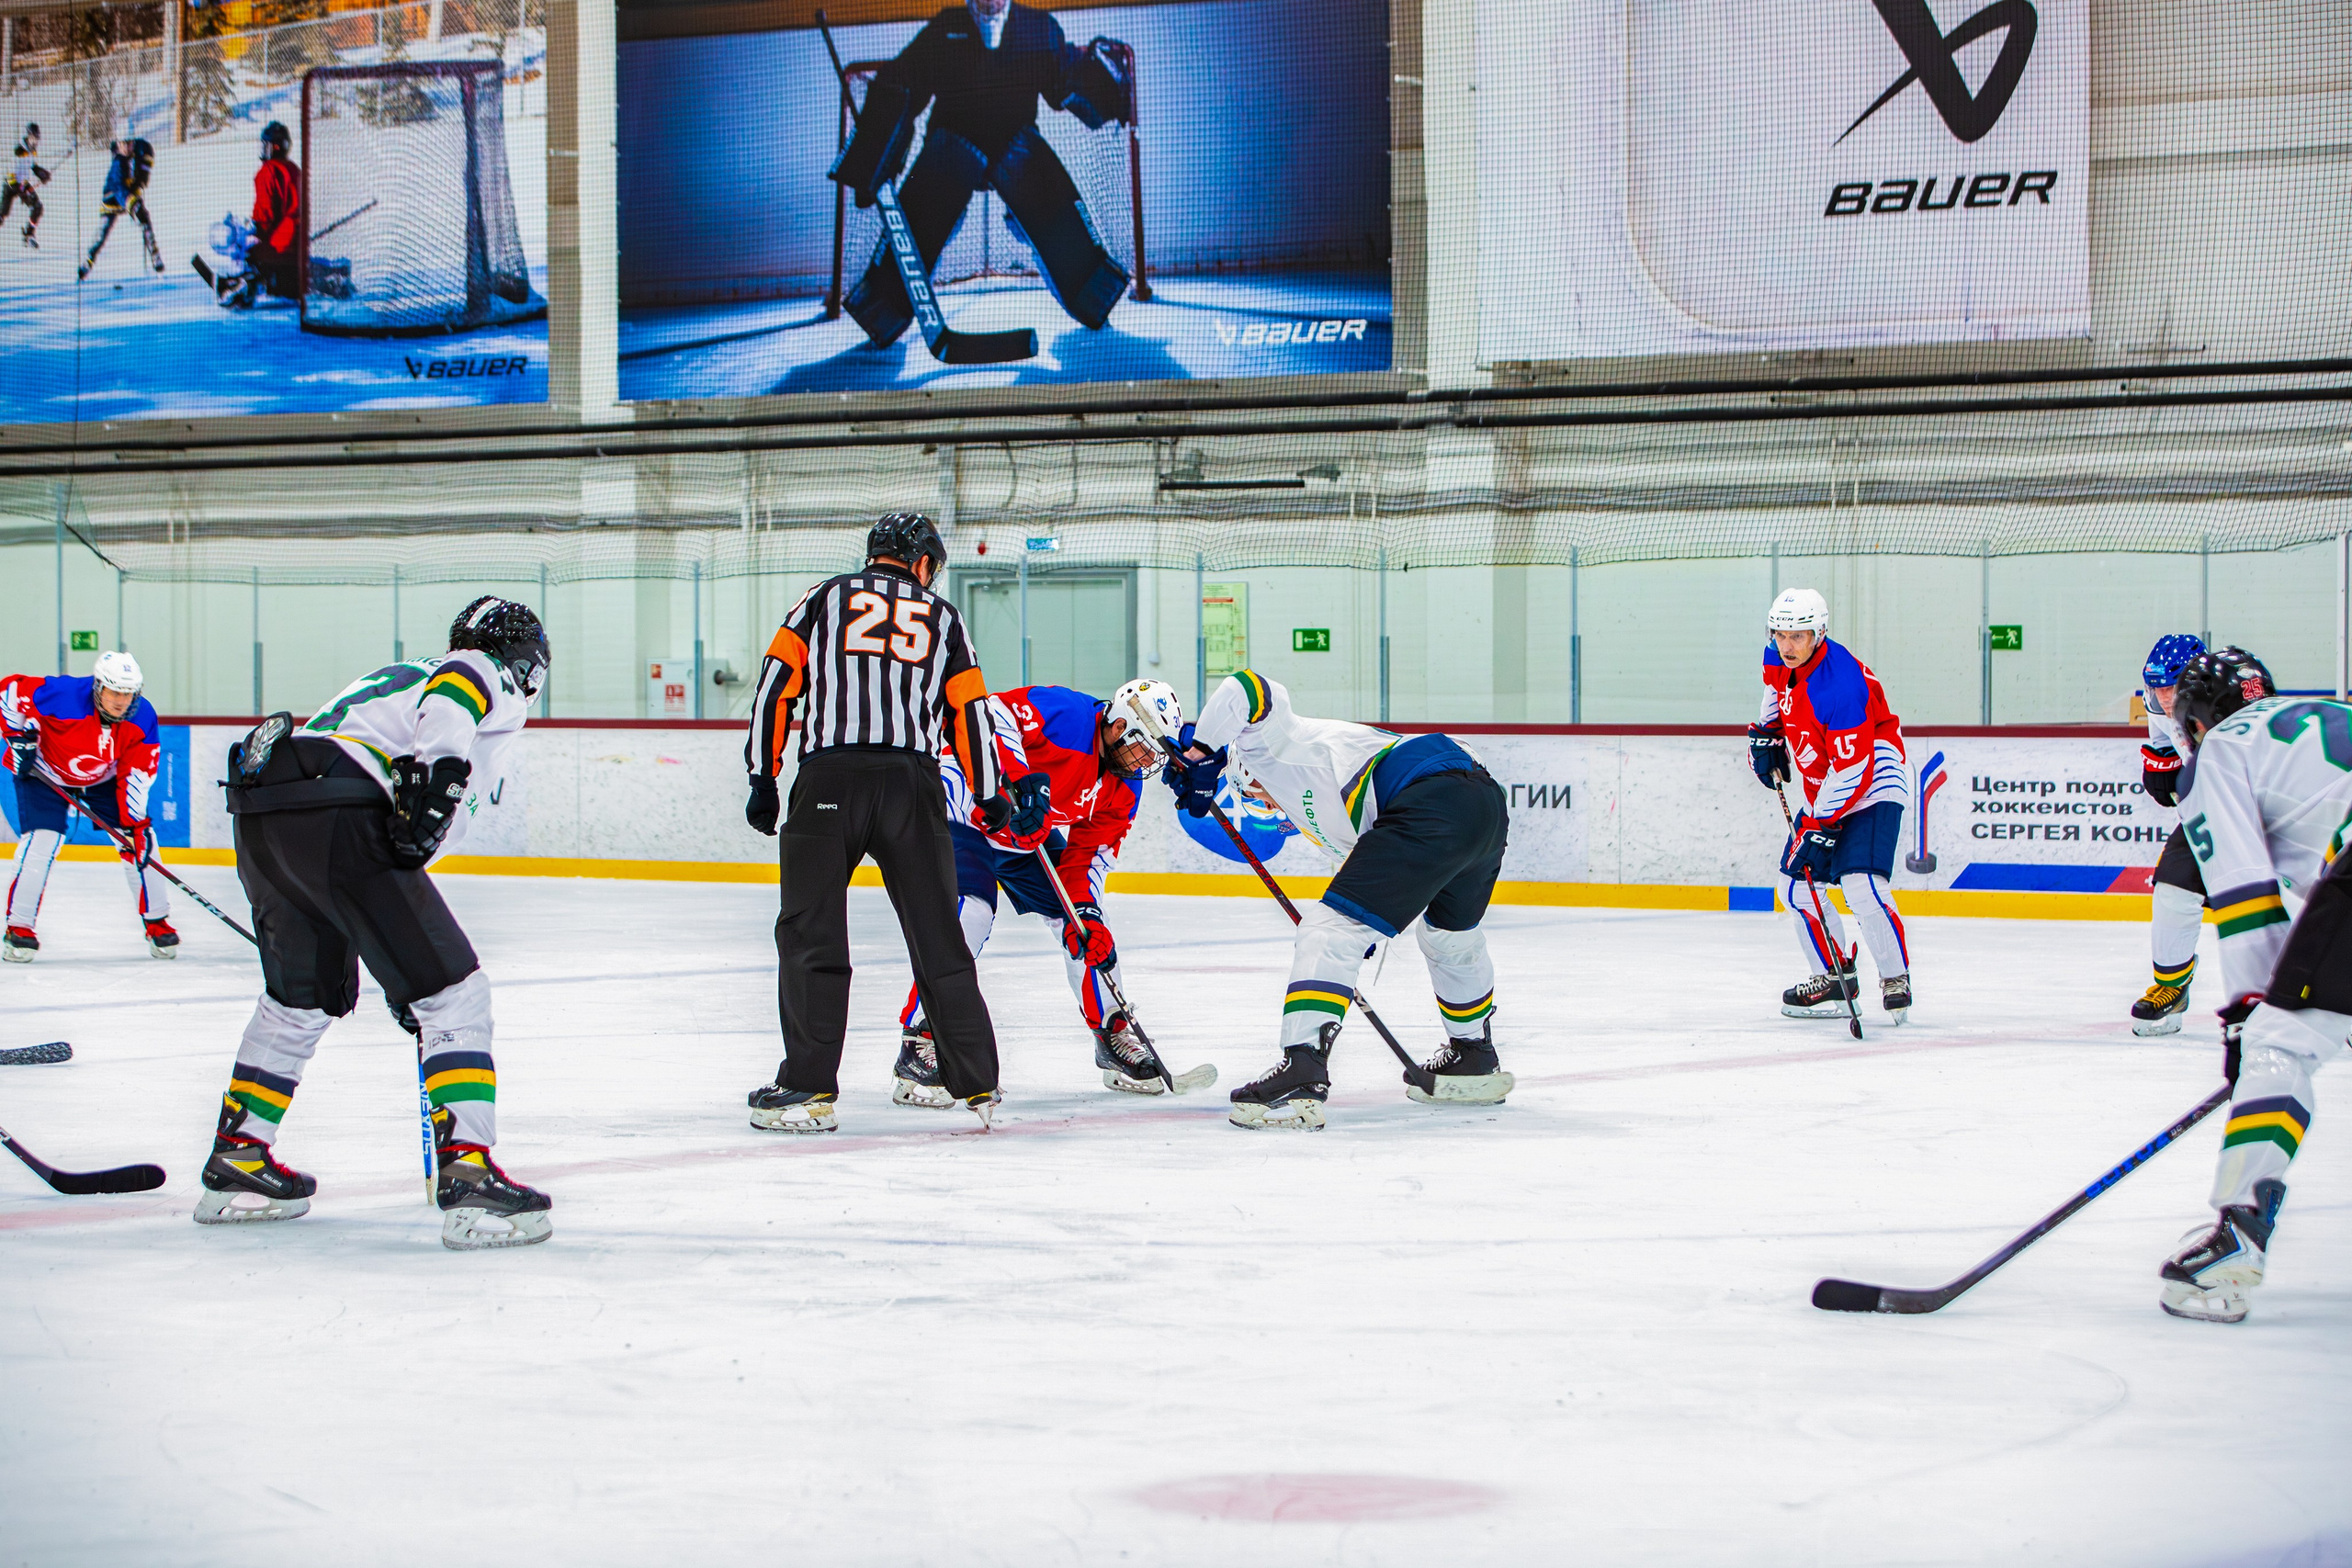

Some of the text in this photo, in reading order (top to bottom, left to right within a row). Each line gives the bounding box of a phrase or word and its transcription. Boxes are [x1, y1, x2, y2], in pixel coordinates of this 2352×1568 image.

[1824, 170, 2058, 217] BAUER
[885, 209, 939, 328] BAUER
[1241, 319, 1367, 345] BAUER
[426, 356, 528, 378] BAUER
[844, 591, 932, 663] 25
[2241, 678, 2263, 700] 25
[1012, 702, 1039, 731] 31
[1834, 733, 1858, 760] 15
[1972, 776, 2056, 796] Центр
[1972, 800, 2133, 815] хоккеистов
[1972, 823, 2080, 840] СЕРГЕЯ
